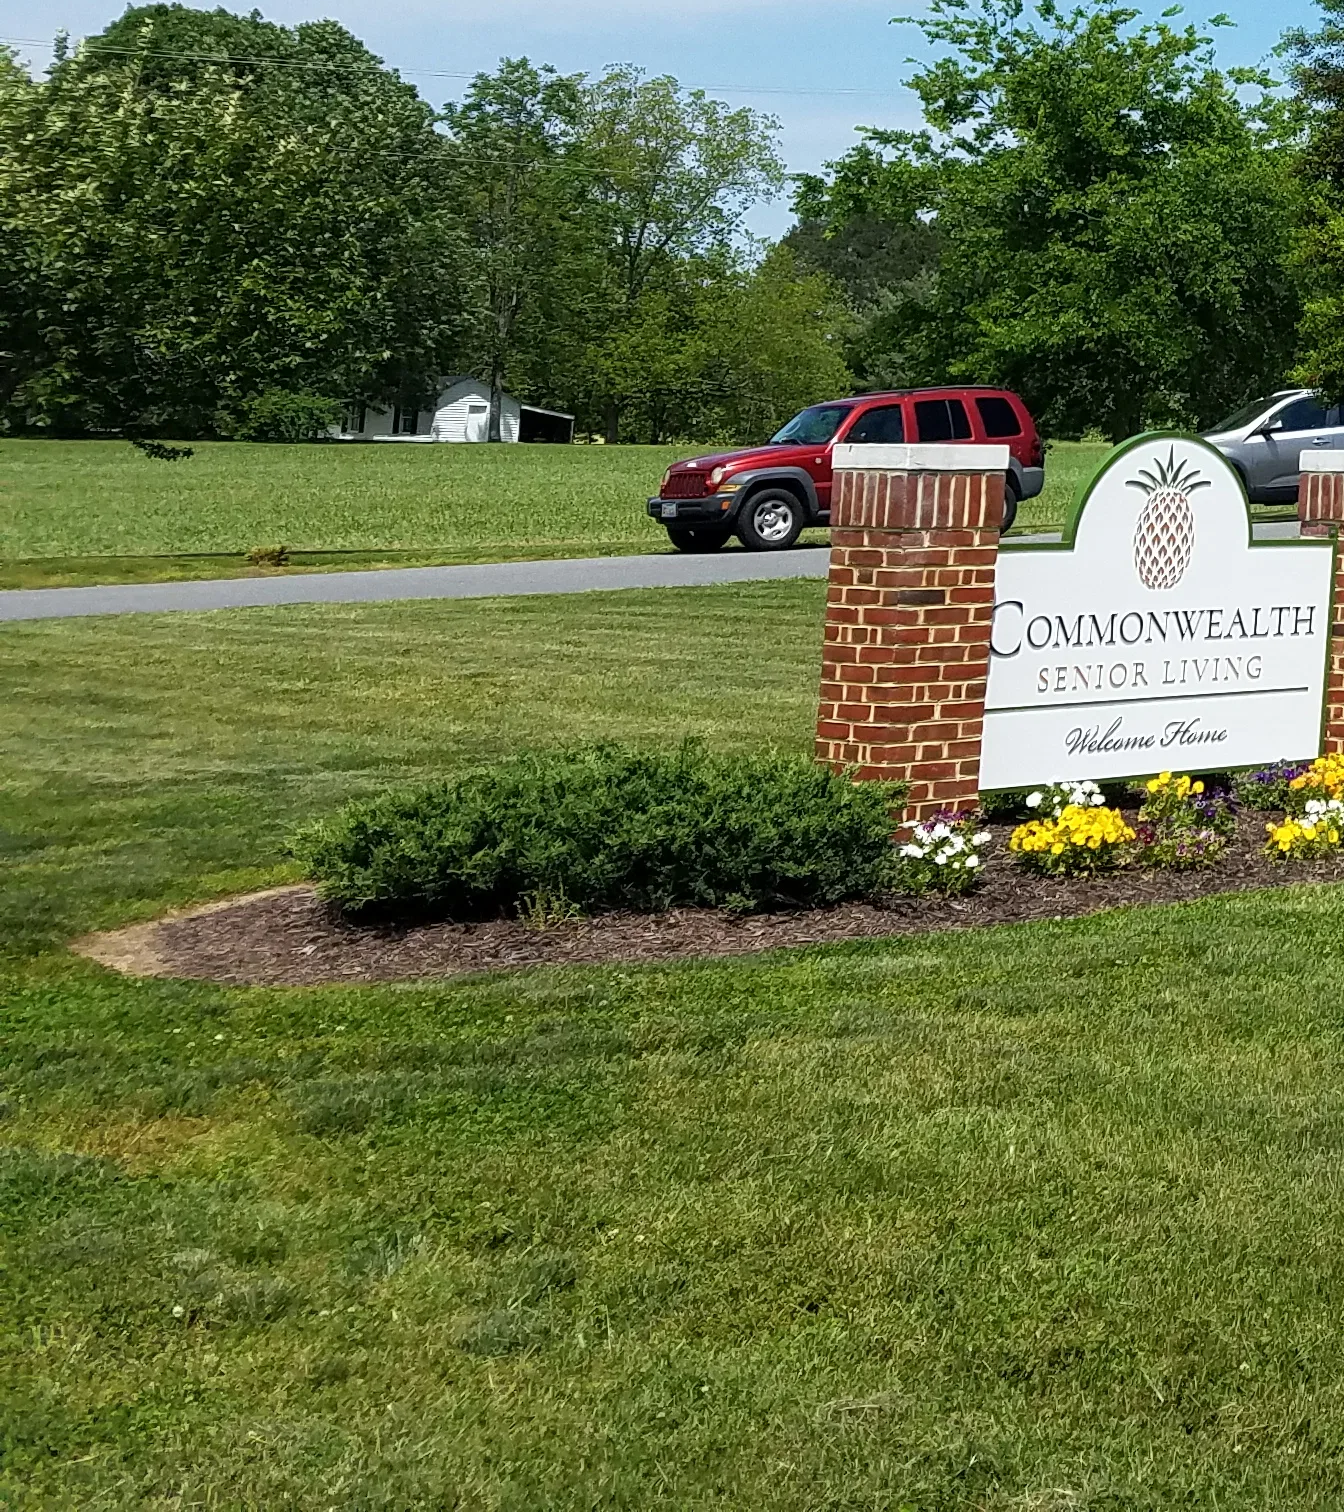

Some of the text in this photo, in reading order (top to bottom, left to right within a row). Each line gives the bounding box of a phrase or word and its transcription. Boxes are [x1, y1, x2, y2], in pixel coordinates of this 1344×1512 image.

[989, 600, 1316, 658] COMMONWEALTH
[1037, 655, 1263, 693] SENIOR LIVING
[1065, 716, 1228, 756] Welcome Home
